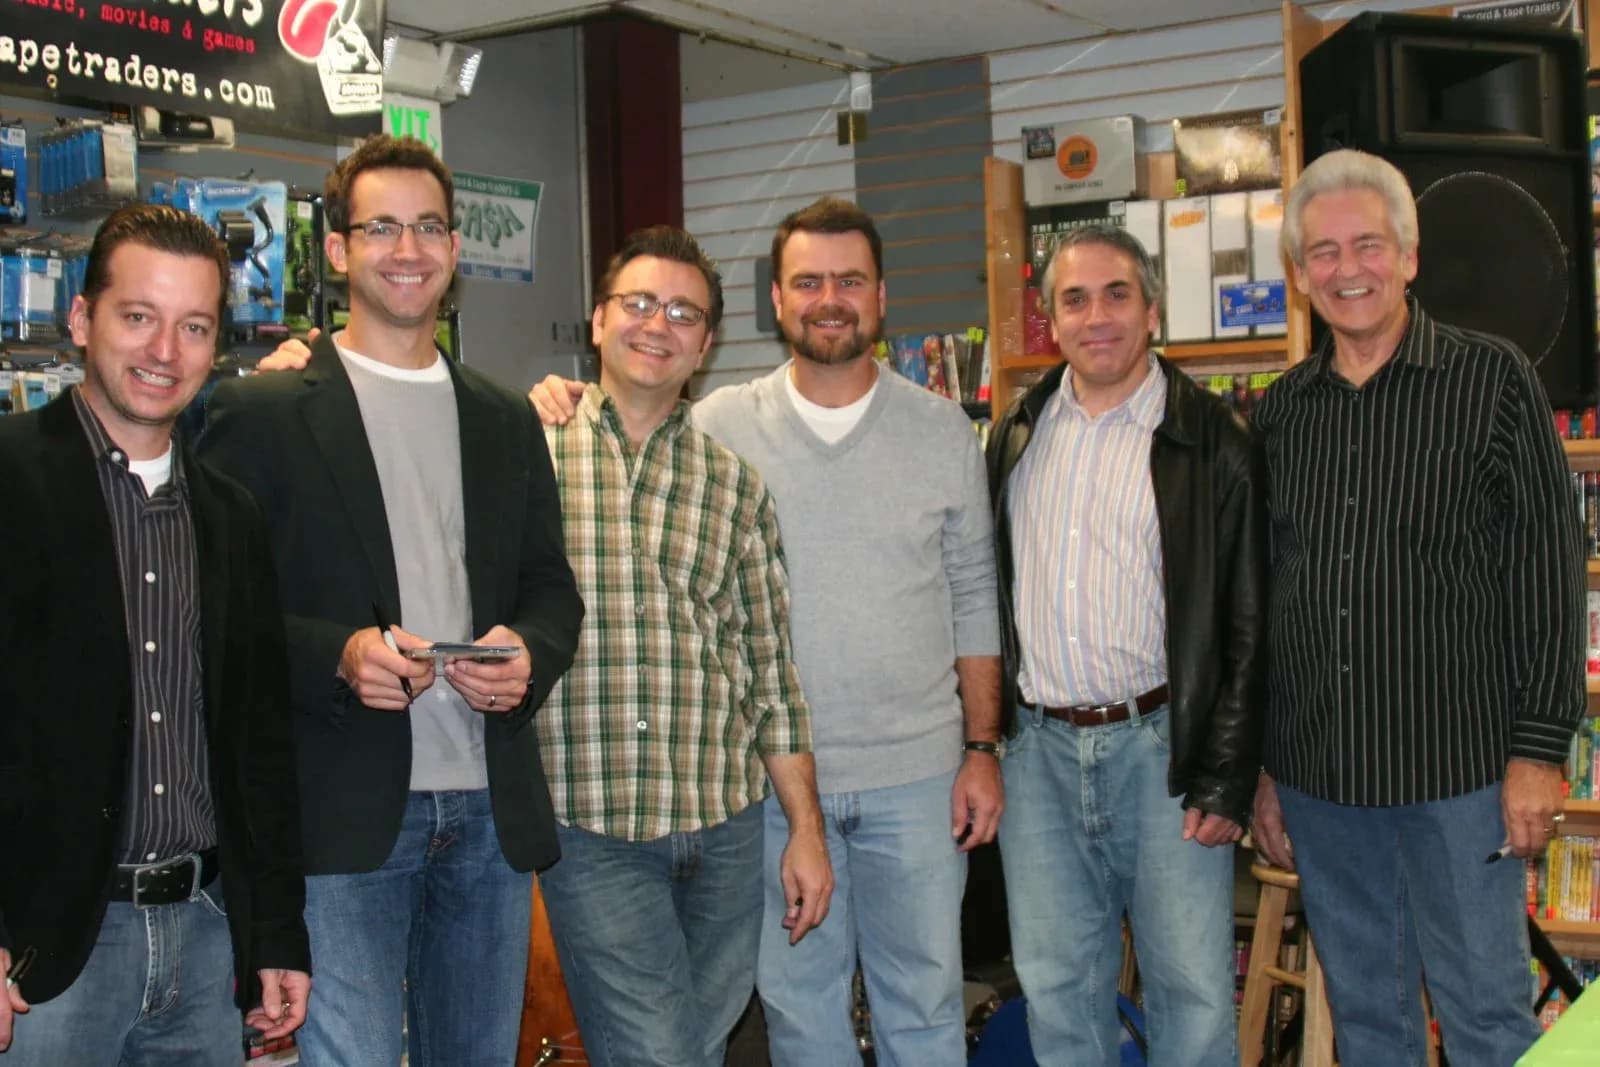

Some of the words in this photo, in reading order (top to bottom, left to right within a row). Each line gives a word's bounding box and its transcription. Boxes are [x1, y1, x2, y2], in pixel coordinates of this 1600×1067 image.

[1503, 7, 1524, 17] tape
[1526, 1, 1560, 15] traders
[101, 4, 170, 34] movies
[181, 19, 193, 39] &
[203, 27, 256, 54] games
